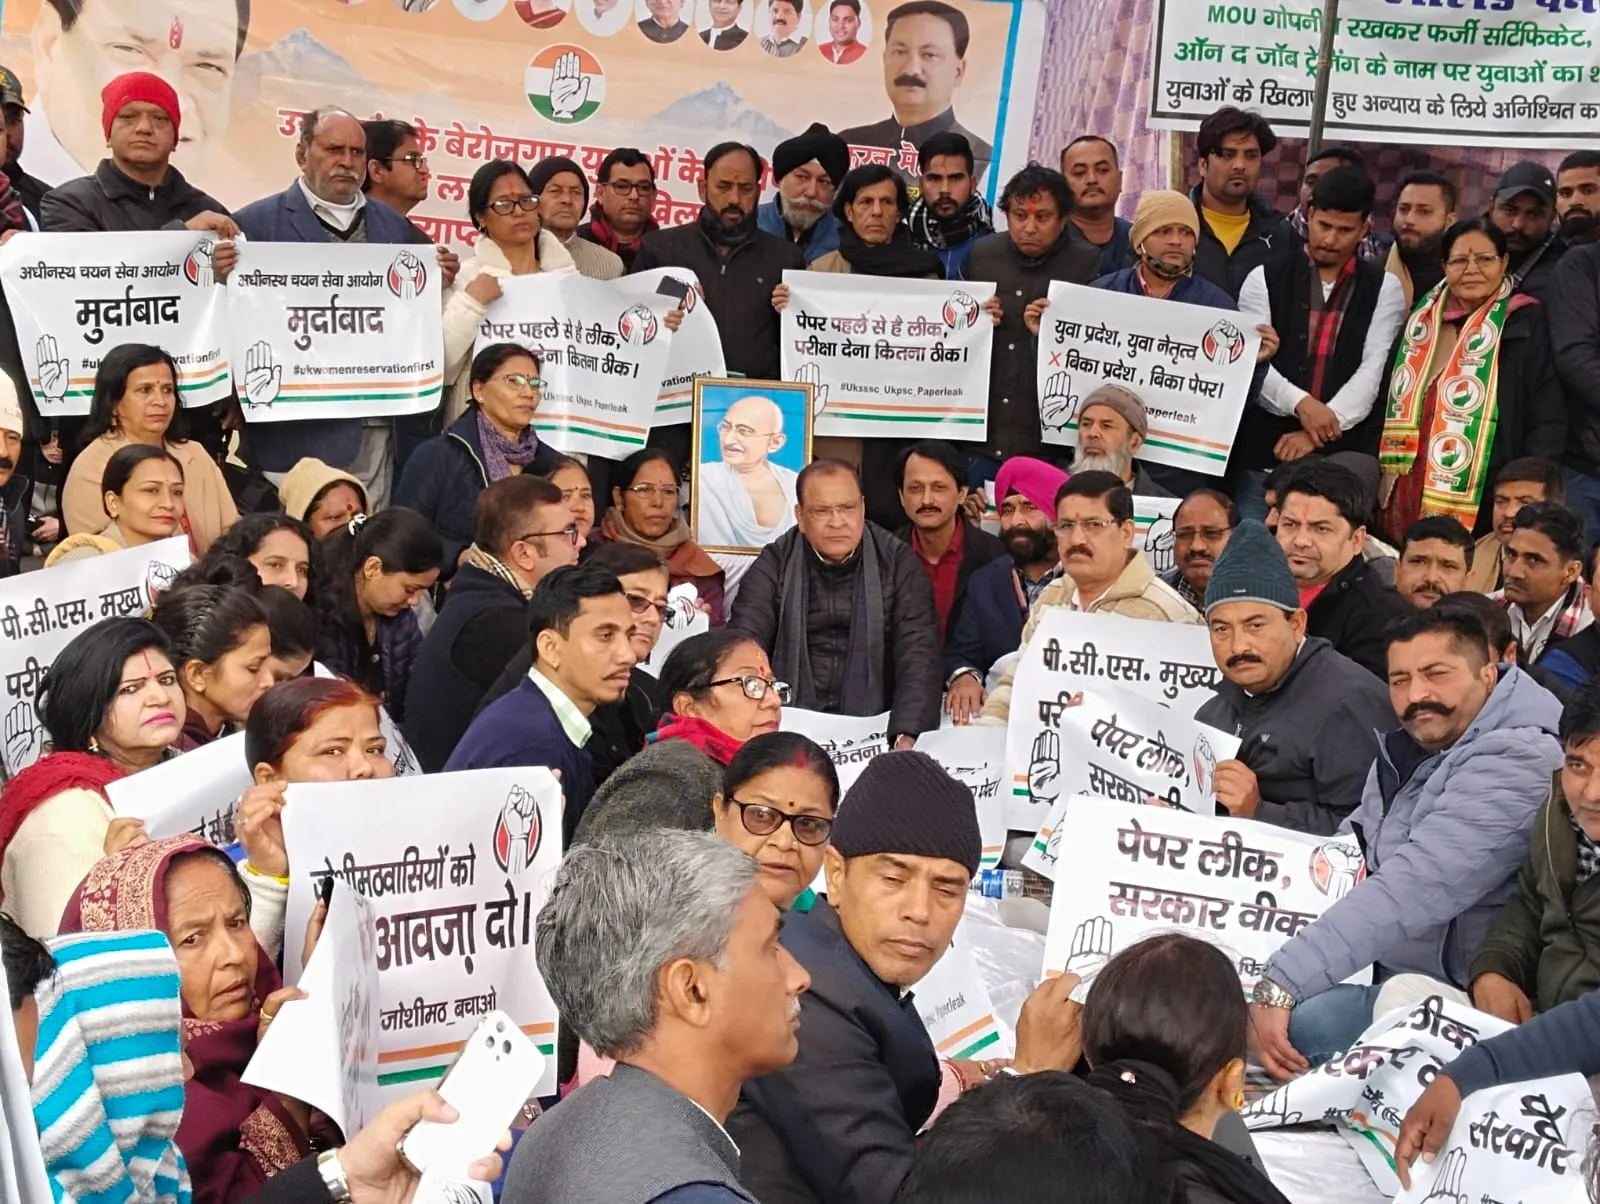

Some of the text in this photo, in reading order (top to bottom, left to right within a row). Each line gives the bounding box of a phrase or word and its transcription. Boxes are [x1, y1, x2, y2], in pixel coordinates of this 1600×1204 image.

[1208, 5, 1256, 25] MOU
[1347, 18, 1424, 41] रखकर
[1427, 19, 1480, 45] फर्जी
[1174, 37, 1225, 63] ऑन
[1231, 45, 1251, 65] द
[1256, 43, 1300, 69] जॉब
[1366, 52, 1387, 76] के
[1394, 60, 1437, 80] नाम
[1443, 63, 1471, 81] पर
[1476, 59, 1548, 92] युवाओं
[1552, 65, 1584, 83] का
[1166, 76, 1231, 110] युवाओं
[1233, 78, 1255, 103] के
[1332, 91, 1358, 120] हुए
[1362, 95, 1421, 116] अन्याय
[1426, 93, 1445, 116] के
[1451, 93, 1487, 118] लिये
[1493, 95, 1576, 119] अनिश्चित
[19, 260, 181, 280] अधीनस्थ चयन सेवा आयोग
[238, 269, 384, 288] अधीनस्थ चयन सेवा आयोग
[75, 284, 181, 345] मुर्दाबाद
[286, 293, 386, 351] मुर्दाबाद
[479, 316, 622, 350] पेपर पहले से है लीक,
[796, 310, 949, 339] पेपर पहले से है लीक,
[567, 347, 599, 374] कितना
[795, 335, 838, 358] परीक्षा
[841, 338, 870, 360] देना
[875, 339, 926, 362] कितना
[1055, 319, 1199, 365] युवा प्रदेश, युवा नेतृत्व
[1065, 348, 1100, 375] बिका
[1149, 365, 1185, 392] बिका
[1043, 637, 1217, 700] पी.सी.एस. मुख्य
[1090, 712, 1144, 760] पेपर
[450, 842, 477, 887] को
[1116, 818, 1292, 891] पेपर लीक,
[1108, 880, 1236, 931] सरकार
